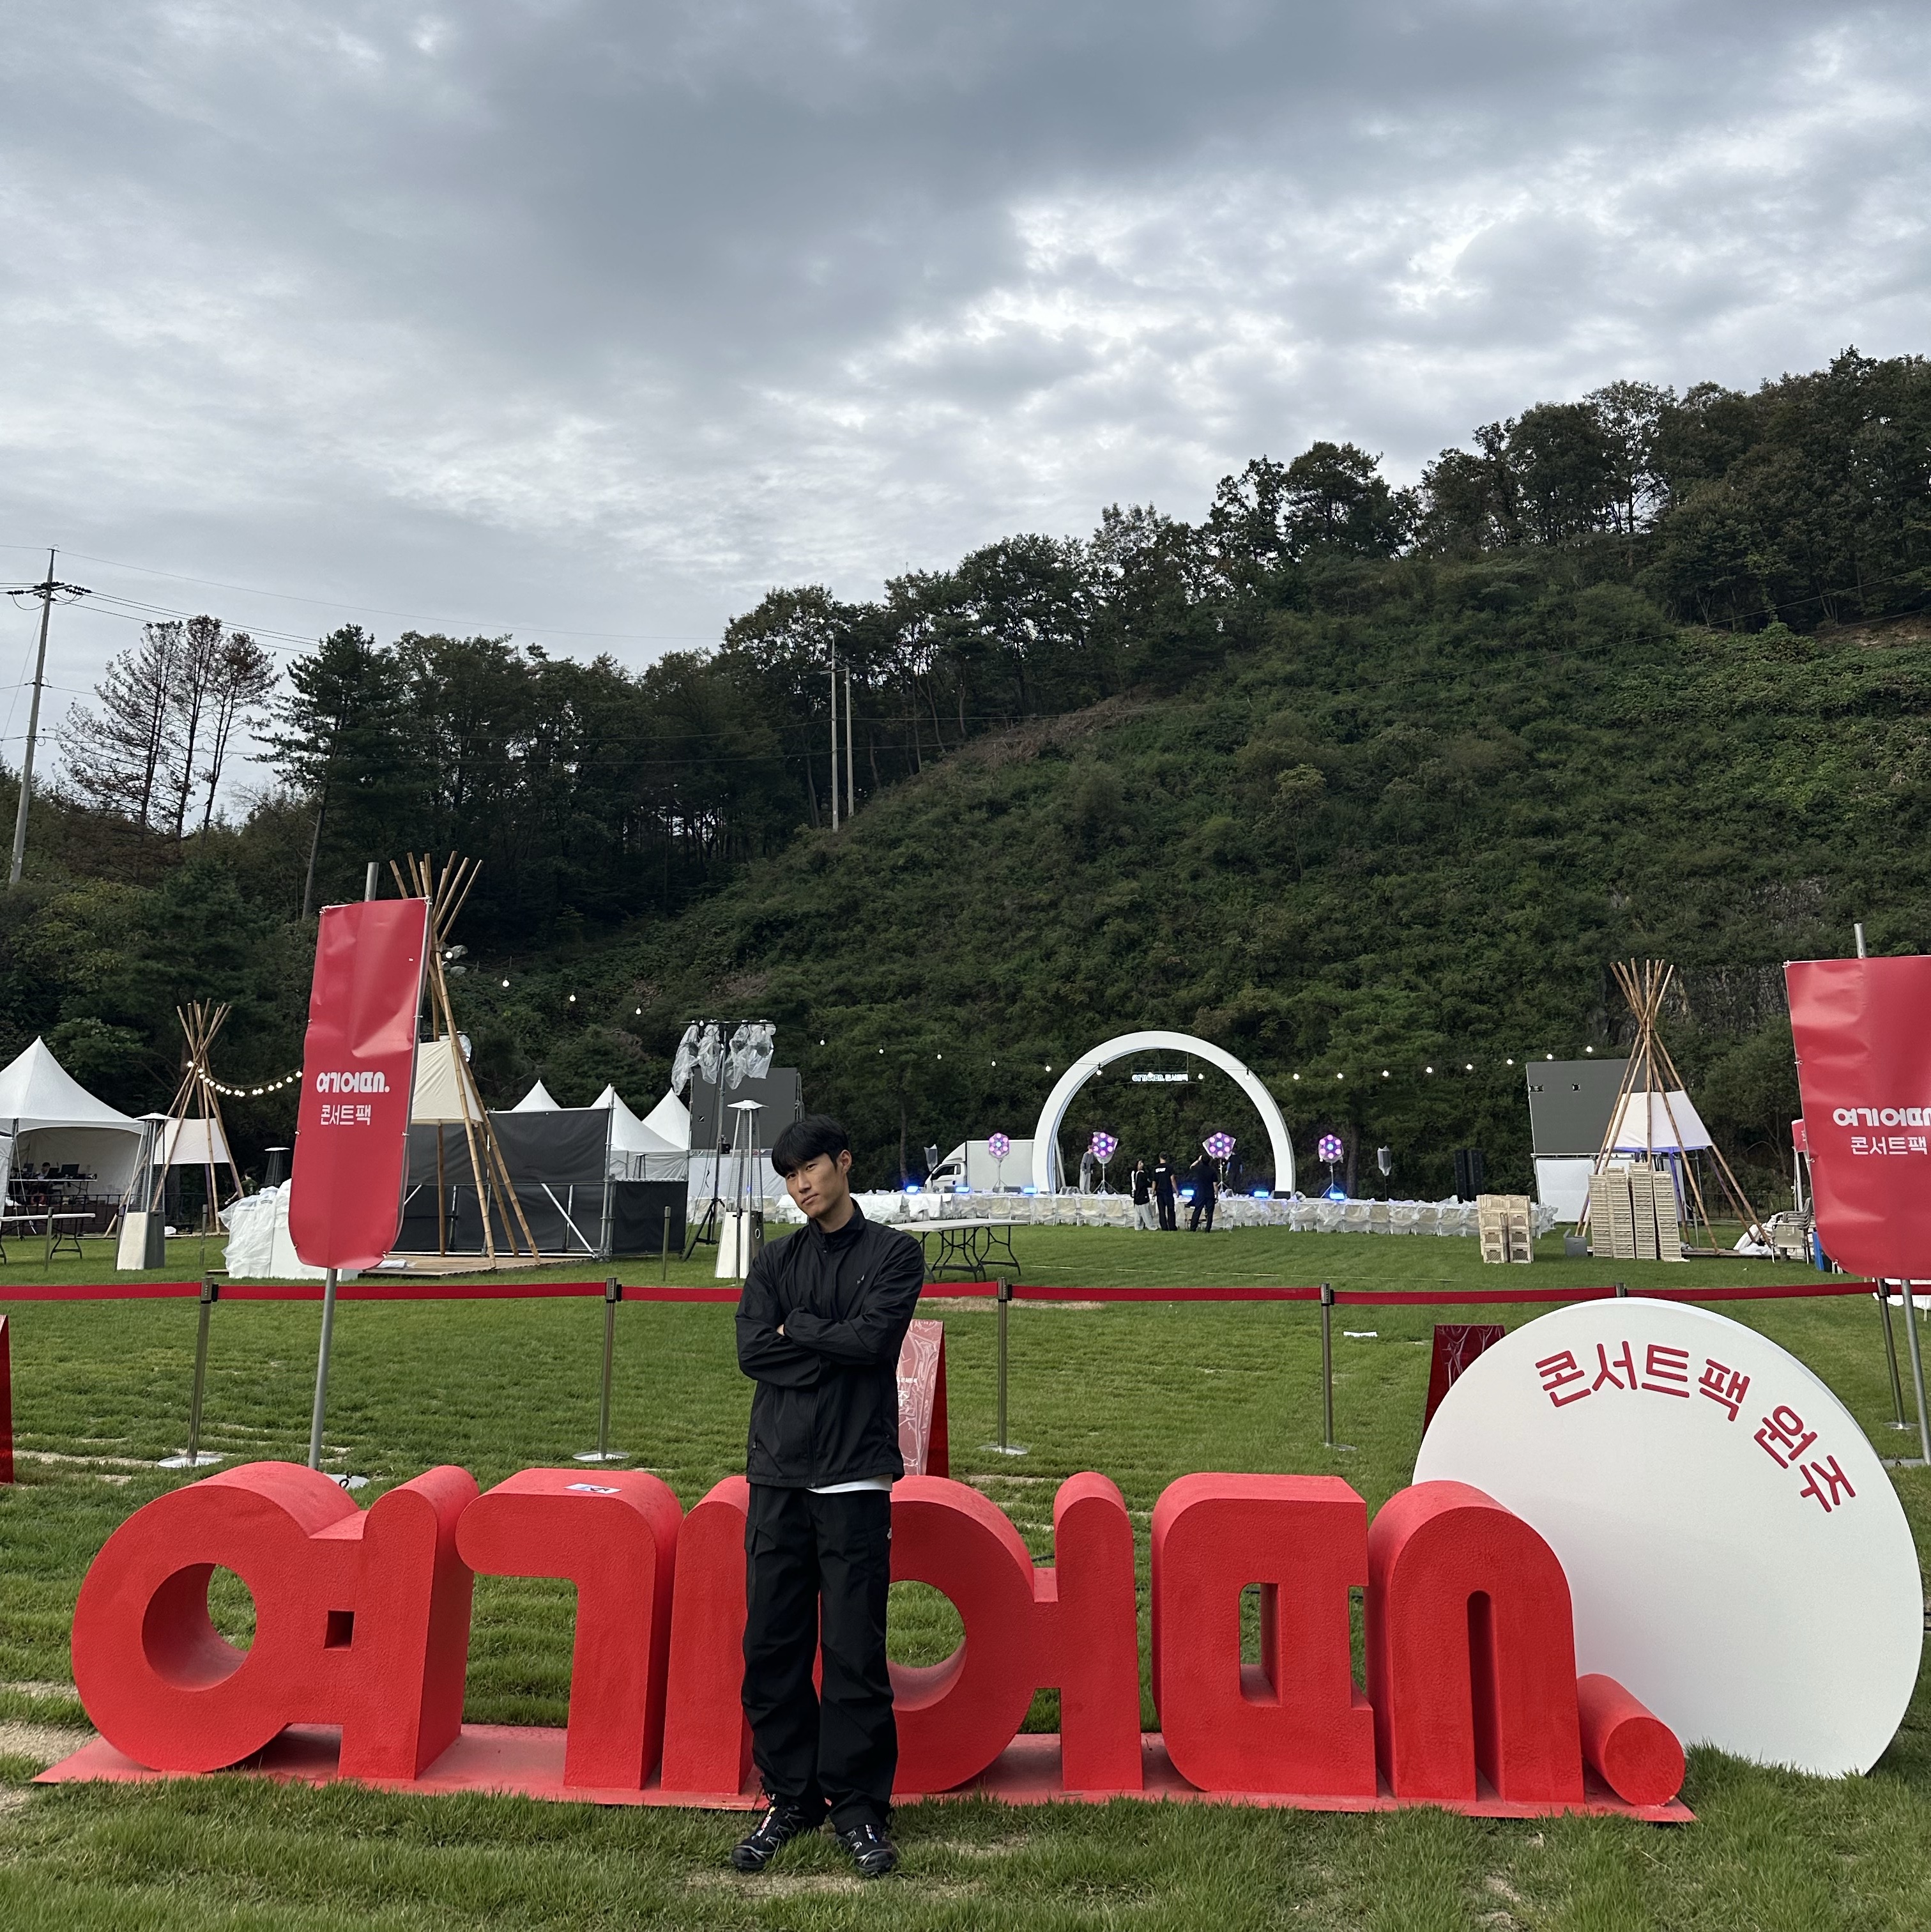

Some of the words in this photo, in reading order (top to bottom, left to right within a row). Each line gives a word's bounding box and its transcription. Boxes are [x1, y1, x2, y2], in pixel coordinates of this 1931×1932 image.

[321, 1104, 371, 1125] 콘서트팩
[1851, 1136, 1928, 1155] 콘서트팩
[1535, 1340, 1750, 1422] 콘서트팩
[1753, 1405, 1856, 1513] 원주
